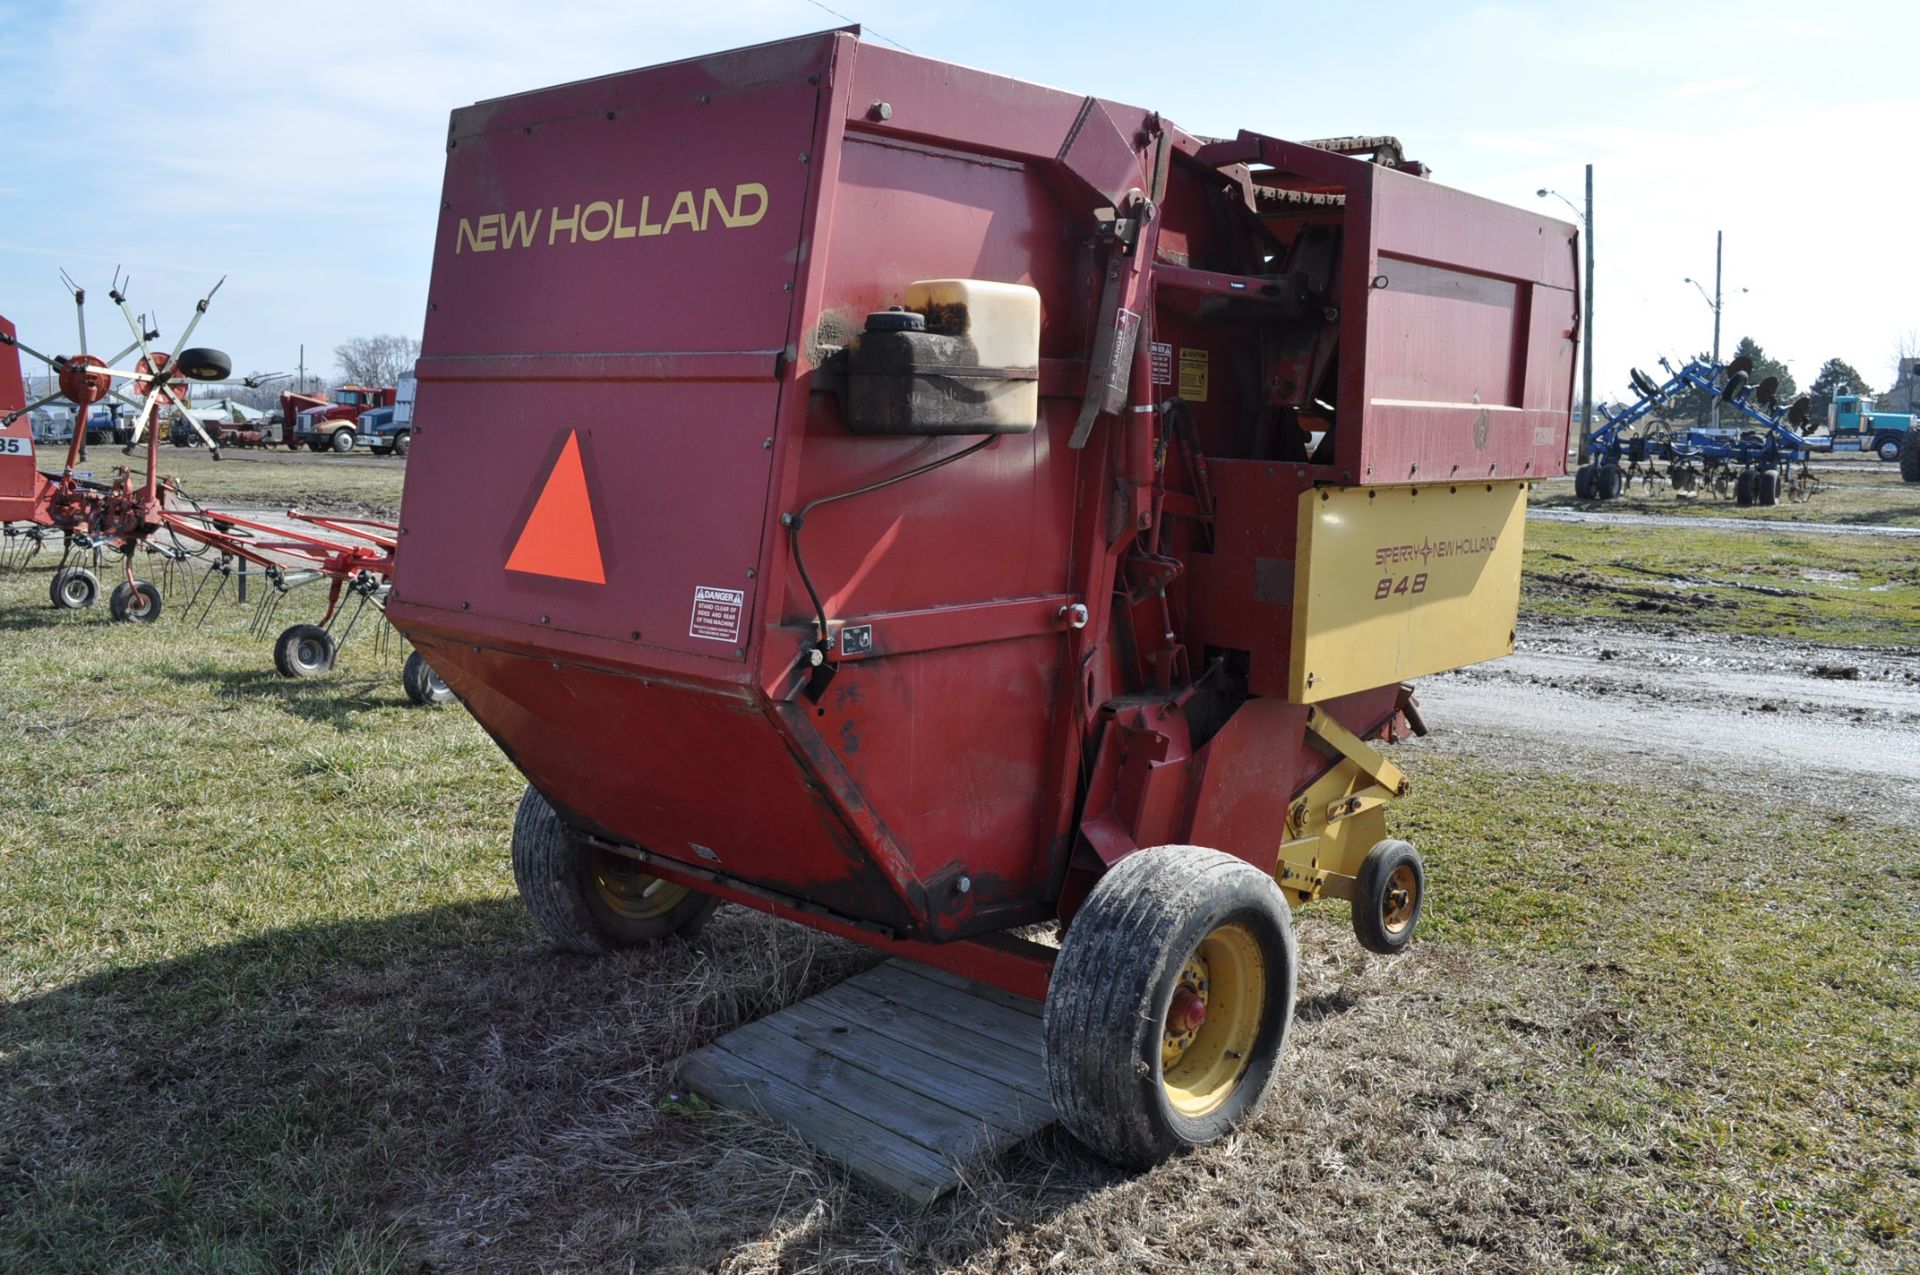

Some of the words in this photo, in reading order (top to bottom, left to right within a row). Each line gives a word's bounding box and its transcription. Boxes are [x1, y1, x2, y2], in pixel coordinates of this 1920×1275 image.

[456, 209, 542, 254] NEW
[549, 182, 769, 245] HOLLAND
[1375, 544, 1420, 566] SPERRY
[1432, 541, 1455, 558] NEW
[1456, 536, 1498, 556] HOLLAND
[704, 590, 734, 602] DANGER
[1374, 573, 1428, 600] 848
